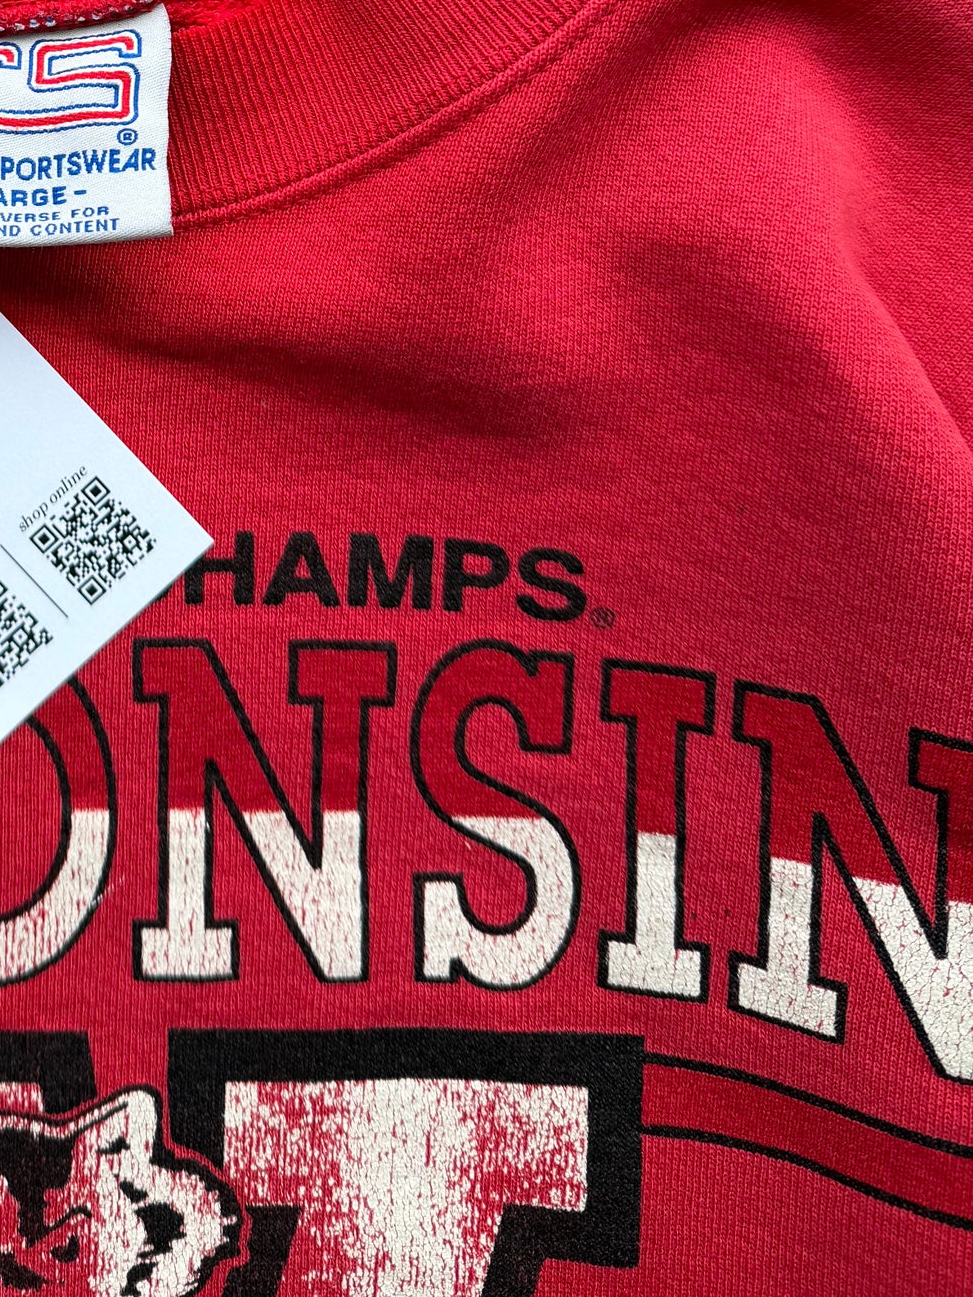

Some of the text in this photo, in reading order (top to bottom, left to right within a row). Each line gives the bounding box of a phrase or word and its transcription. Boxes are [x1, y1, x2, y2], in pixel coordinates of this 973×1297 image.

[30, 218, 120, 237] CONTENT
[71, 206, 110, 218] FOR
[18, 465, 88, 532] shop online
[155, 531, 588, 622] HAMPS
